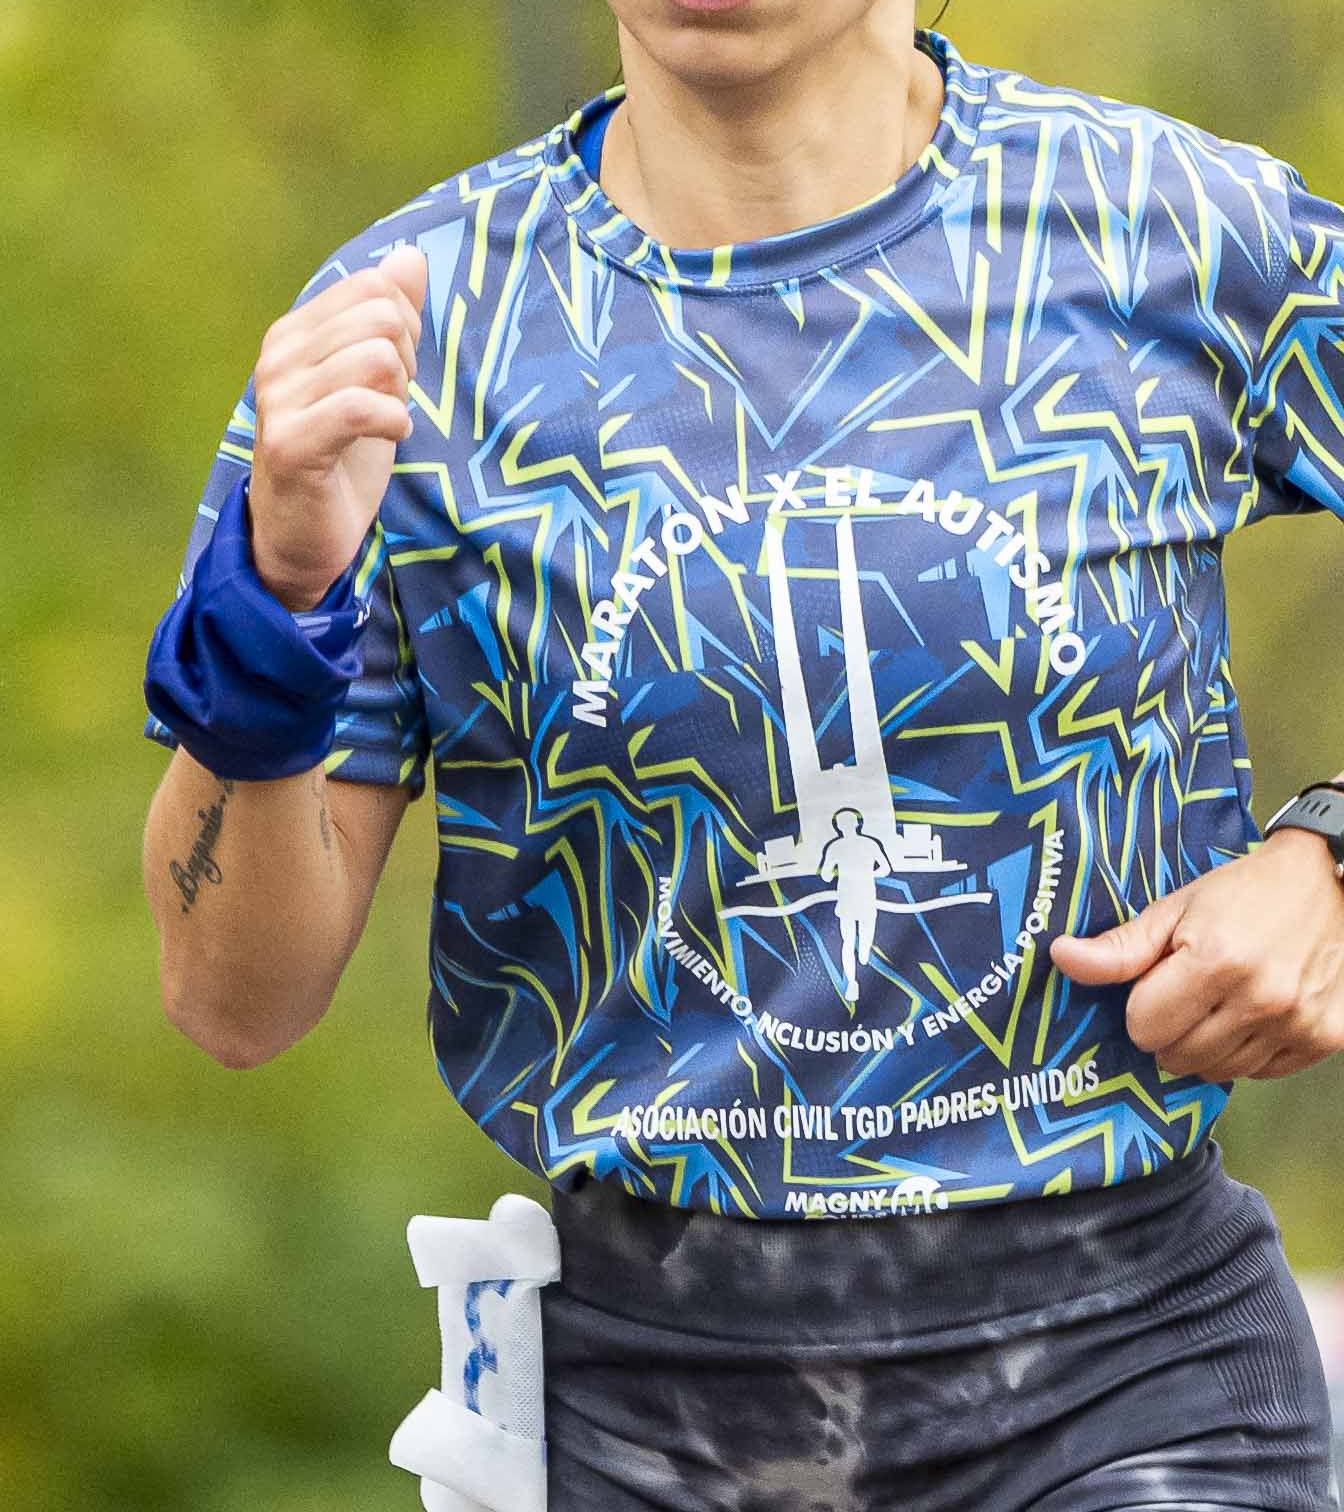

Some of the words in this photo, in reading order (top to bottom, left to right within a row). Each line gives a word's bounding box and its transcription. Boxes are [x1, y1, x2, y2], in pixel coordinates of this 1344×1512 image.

[573, 484, 750, 727] MARATÓN
[764, 470, 806, 513] X
[825, 467, 881, 508] EL
[896, 478, 1086, 675] AUTISMO
[756, 1011, 895, 1053] NCLUSIÓN
[897, 1022, 914, 1045] Y
[922, 952, 1025, 1038] ENERGÍA
[1015, 829, 1064, 950] POSITIVA
[611, 1098, 767, 1140] ASOCIACIÓN
[773, 1104, 839, 1140] CIVIL
[841, 1105, 894, 1141] TGD
[901, 1082, 998, 1135] PADRES
[1002, 1059, 1100, 1112] UNIDOS
[784, 1188, 888, 1214] MAGNY
